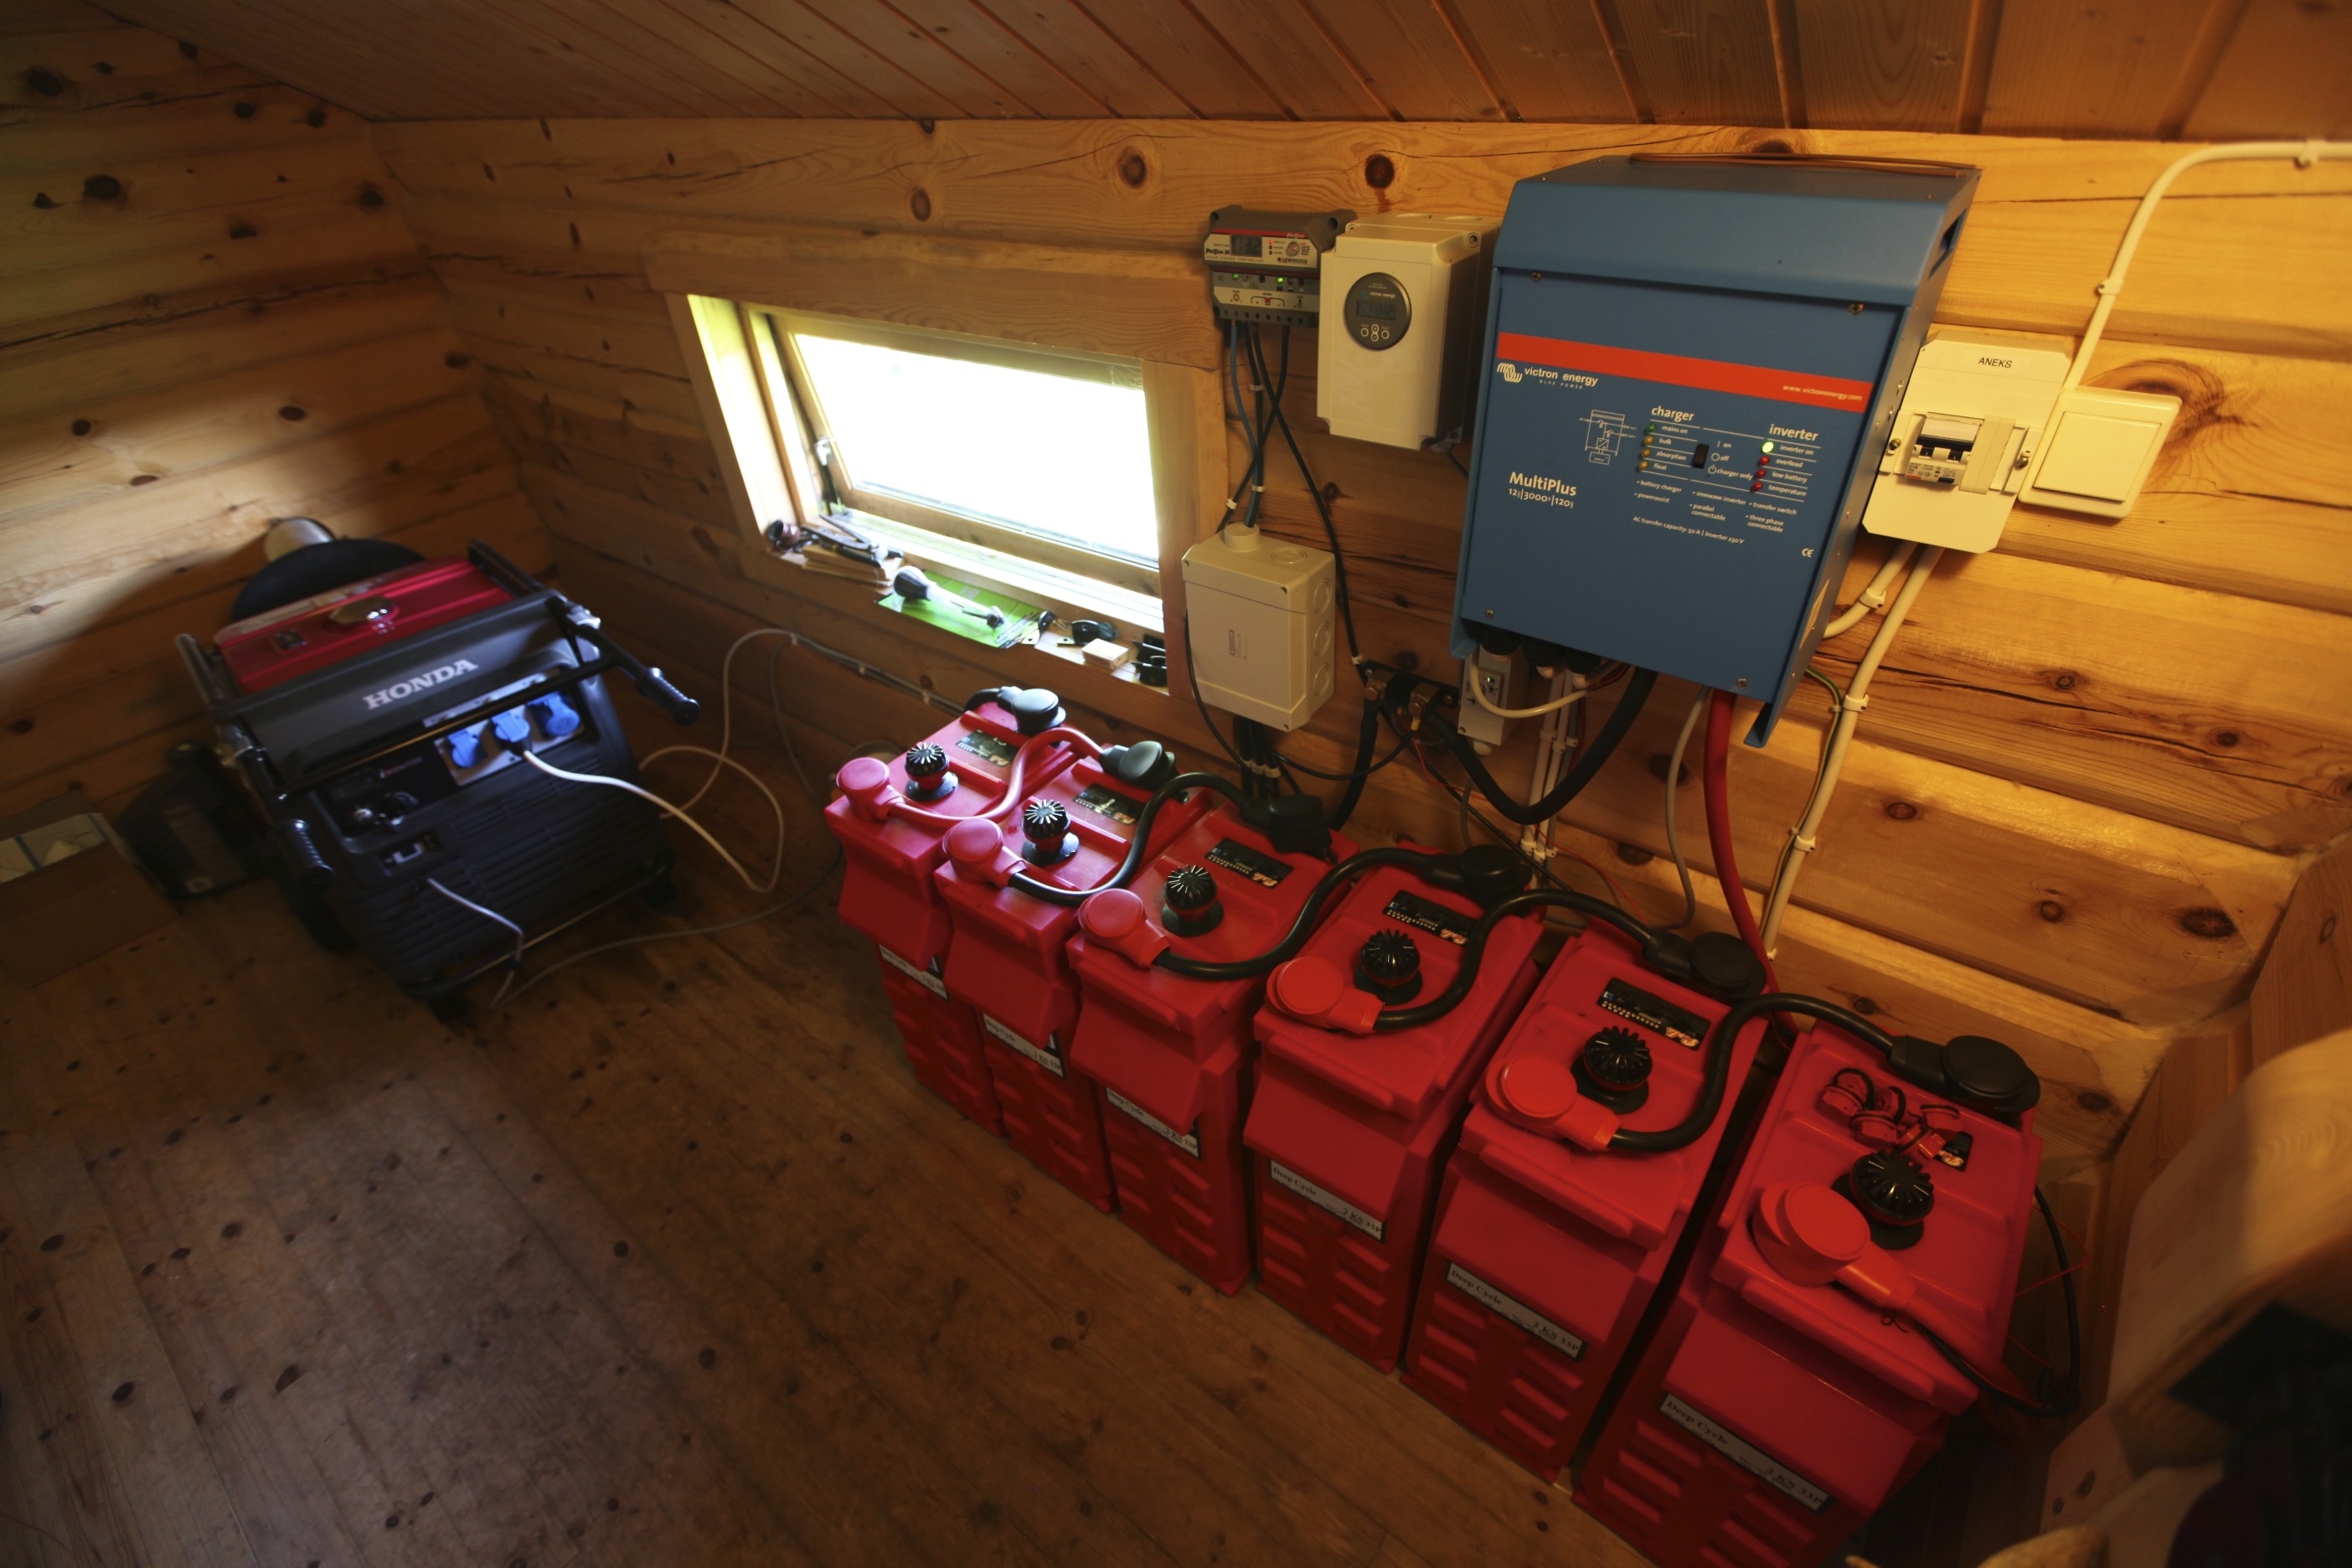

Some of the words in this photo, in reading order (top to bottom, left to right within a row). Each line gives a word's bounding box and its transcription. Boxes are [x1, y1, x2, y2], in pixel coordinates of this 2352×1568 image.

[1978, 357, 2013, 369] ANEKS
[1524, 366, 1558, 379] victron
[1563, 373, 1598, 387] energy
[1651, 405, 1694, 422] charger
[1769, 424, 1818, 441] inverter
[1656, 451, 1687, 461] absorption
[1780, 445, 1804, 454] inverter
[1776, 458, 1803, 468] overload
[1717, 468, 1739, 479] charger
[1740, 472, 1753, 481] only
[1786, 473, 1808, 484] battery
[1509, 472, 1577, 496] MultiPlus
[1641, 480, 1660, 490] battery
[1661, 484, 1682, 493] charger
[1769, 484, 1807, 497] temperature
[1638, 493, 1670, 503] powerassist
[1696, 491, 1723, 501] sinewave
[1723, 496, 1746, 505] inverter
[1694, 503, 1715, 512] parallel
[1753, 502, 1777, 511] transfer
[1777, 507, 1797, 515] switch
[1692, 509, 1725, 521] connectable
[1750, 514, 1766, 523] three
[1767, 518, 1784, 527] phase
[1642, 518, 1663, 527] transfer
[1728, 536, 1739, 544] 230
[1747, 521, 1783, 533] connectable
[362, 659, 479, 709] HONDA
[1109, 1090, 1124, 1105] Deep
[1125, 1101, 1143, 1117] Cycle
[1273, 1167, 1293, 1183] Deep
[1294, 1179, 1316, 1195] Cycle
[1452, 1269, 1473, 1287] Deep
[1476, 1285, 1502, 1305] Cycle
[1541, 1326, 1557, 1339] KS
[1560, 1337, 1580, 1351] 33P
[1667, 1401, 1694, 1423] Deep
[1697, 1421, 1728, 1445] Cycle
[1767, 1467, 1774, 1475] 2
[1777, 1473, 1796, 1489] KS
[1797, 1488, 1823, 1504] 33P
